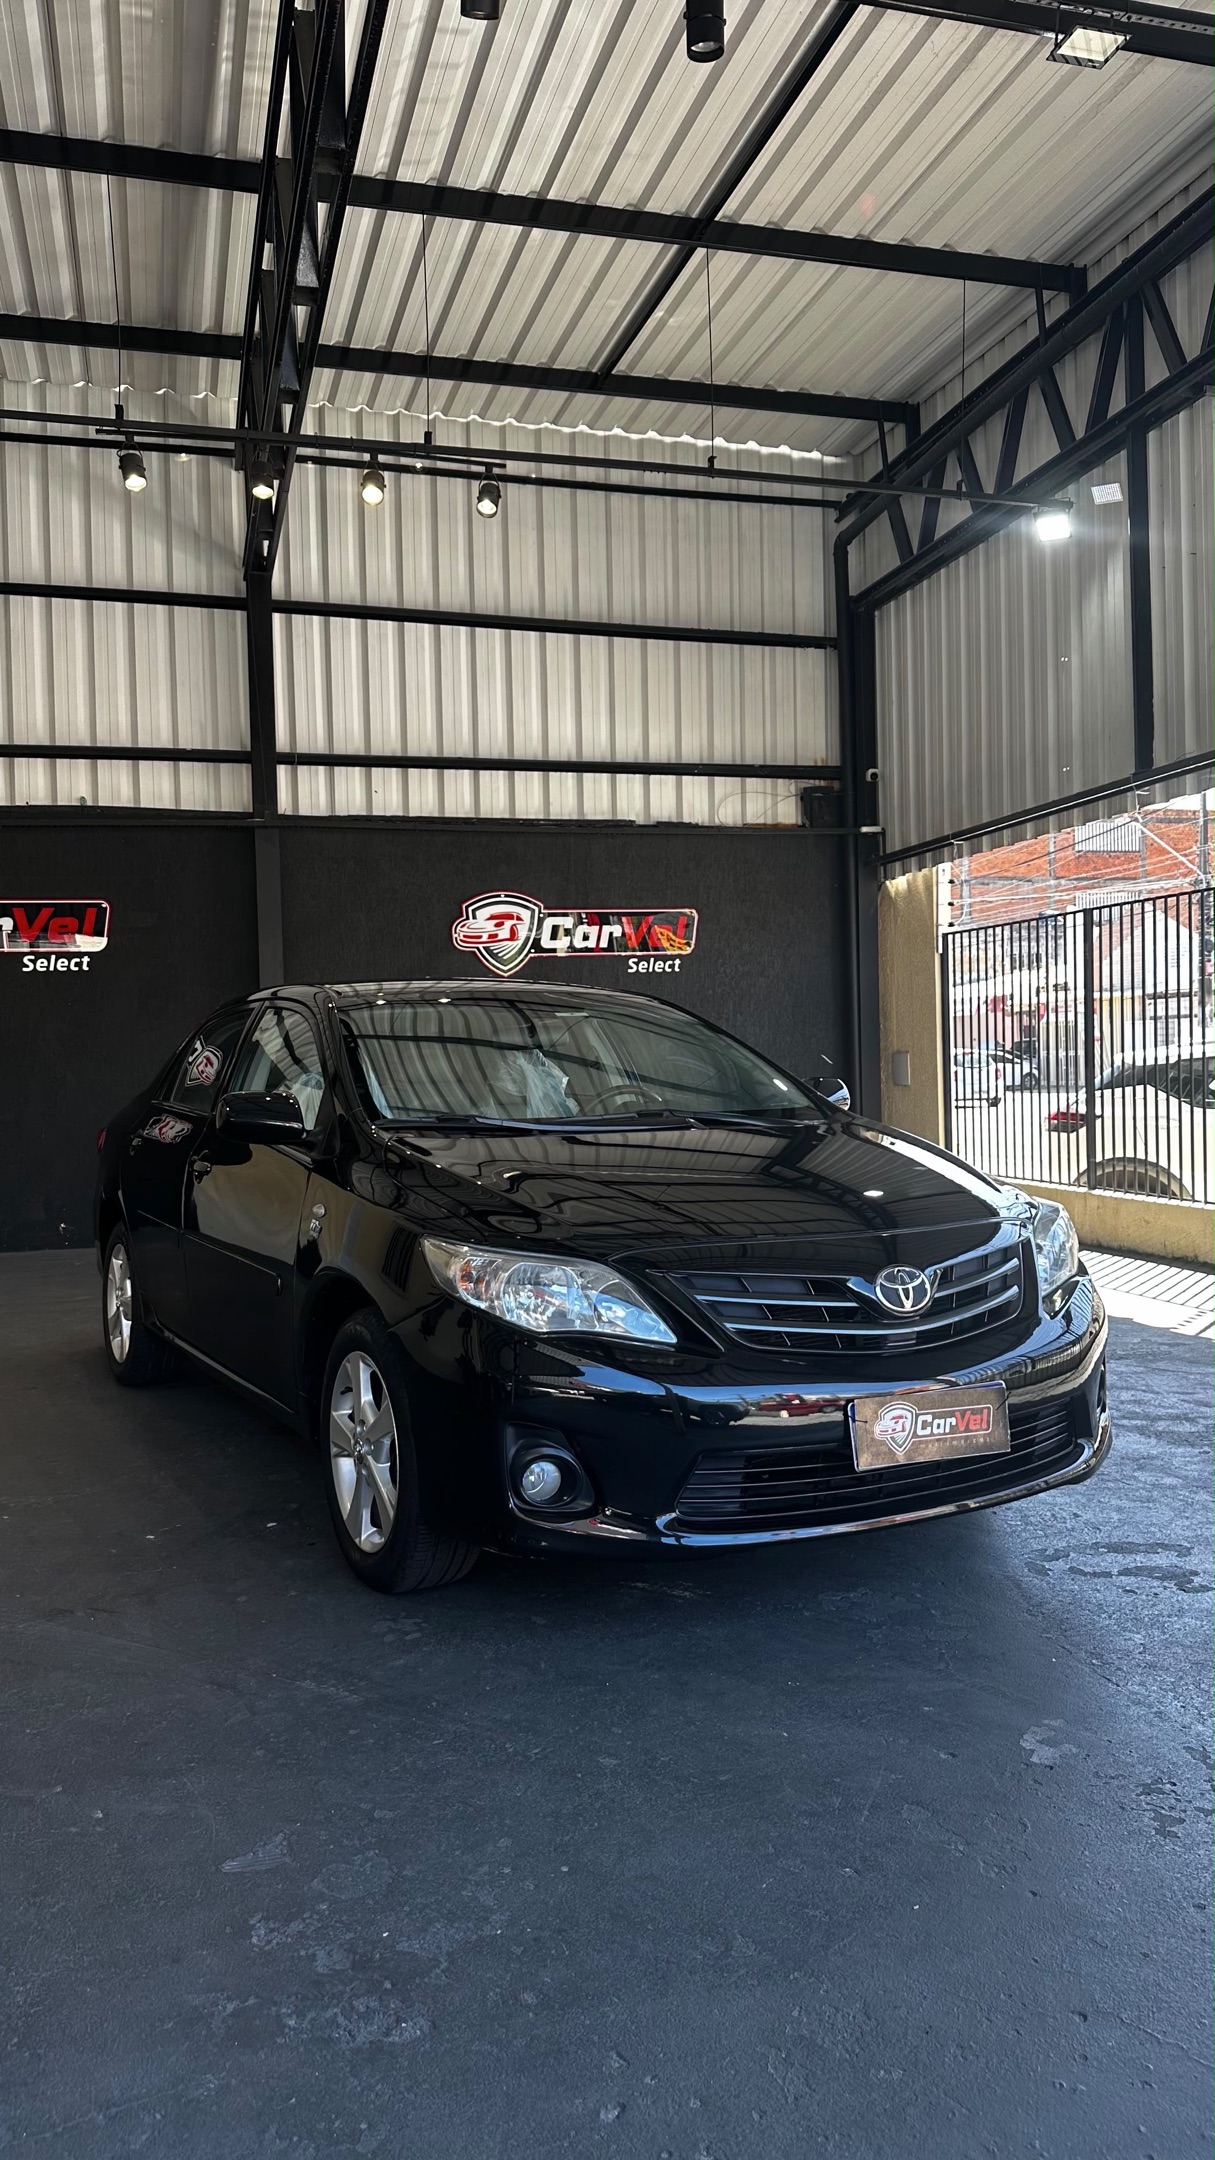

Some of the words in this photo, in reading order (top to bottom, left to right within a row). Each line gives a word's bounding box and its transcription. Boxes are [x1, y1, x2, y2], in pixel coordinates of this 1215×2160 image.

[22, 954, 91, 972] Select
[627, 957, 682, 973] Select
[916, 1409, 988, 1436] CarVel
